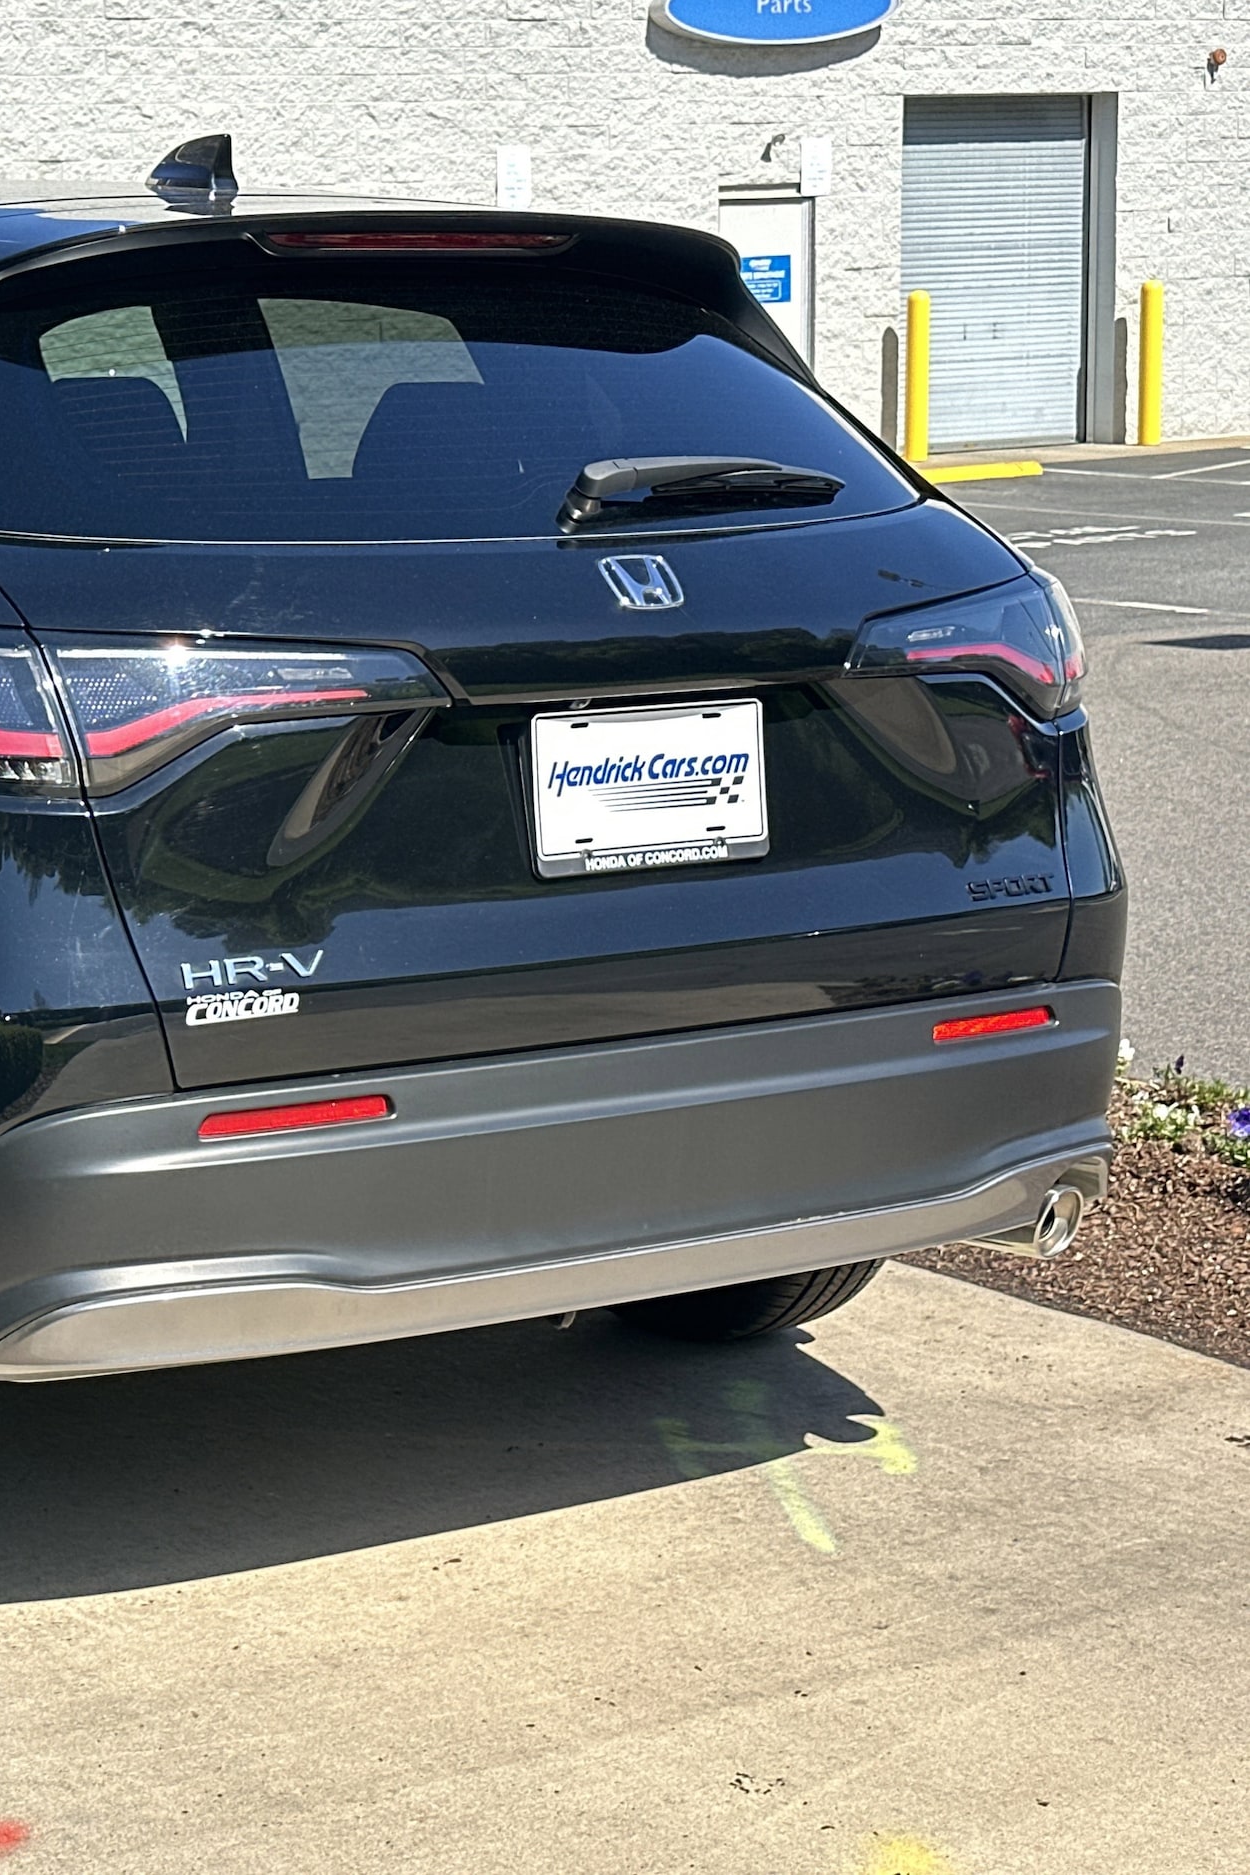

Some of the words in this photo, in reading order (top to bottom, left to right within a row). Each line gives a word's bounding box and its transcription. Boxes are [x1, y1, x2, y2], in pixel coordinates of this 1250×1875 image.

[756, 0, 812, 14] Parts
[585, 855, 627, 870] HONDA
[630, 853, 643, 866] OF
[644, 844, 728, 866] CONCORD.COM
[965, 873, 1054, 901] SPORT
[180, 949, 324, 990] HR-V
[185, 993, 300, 1026] CONCORD
[186, 990, 259, 1006] HONDA
